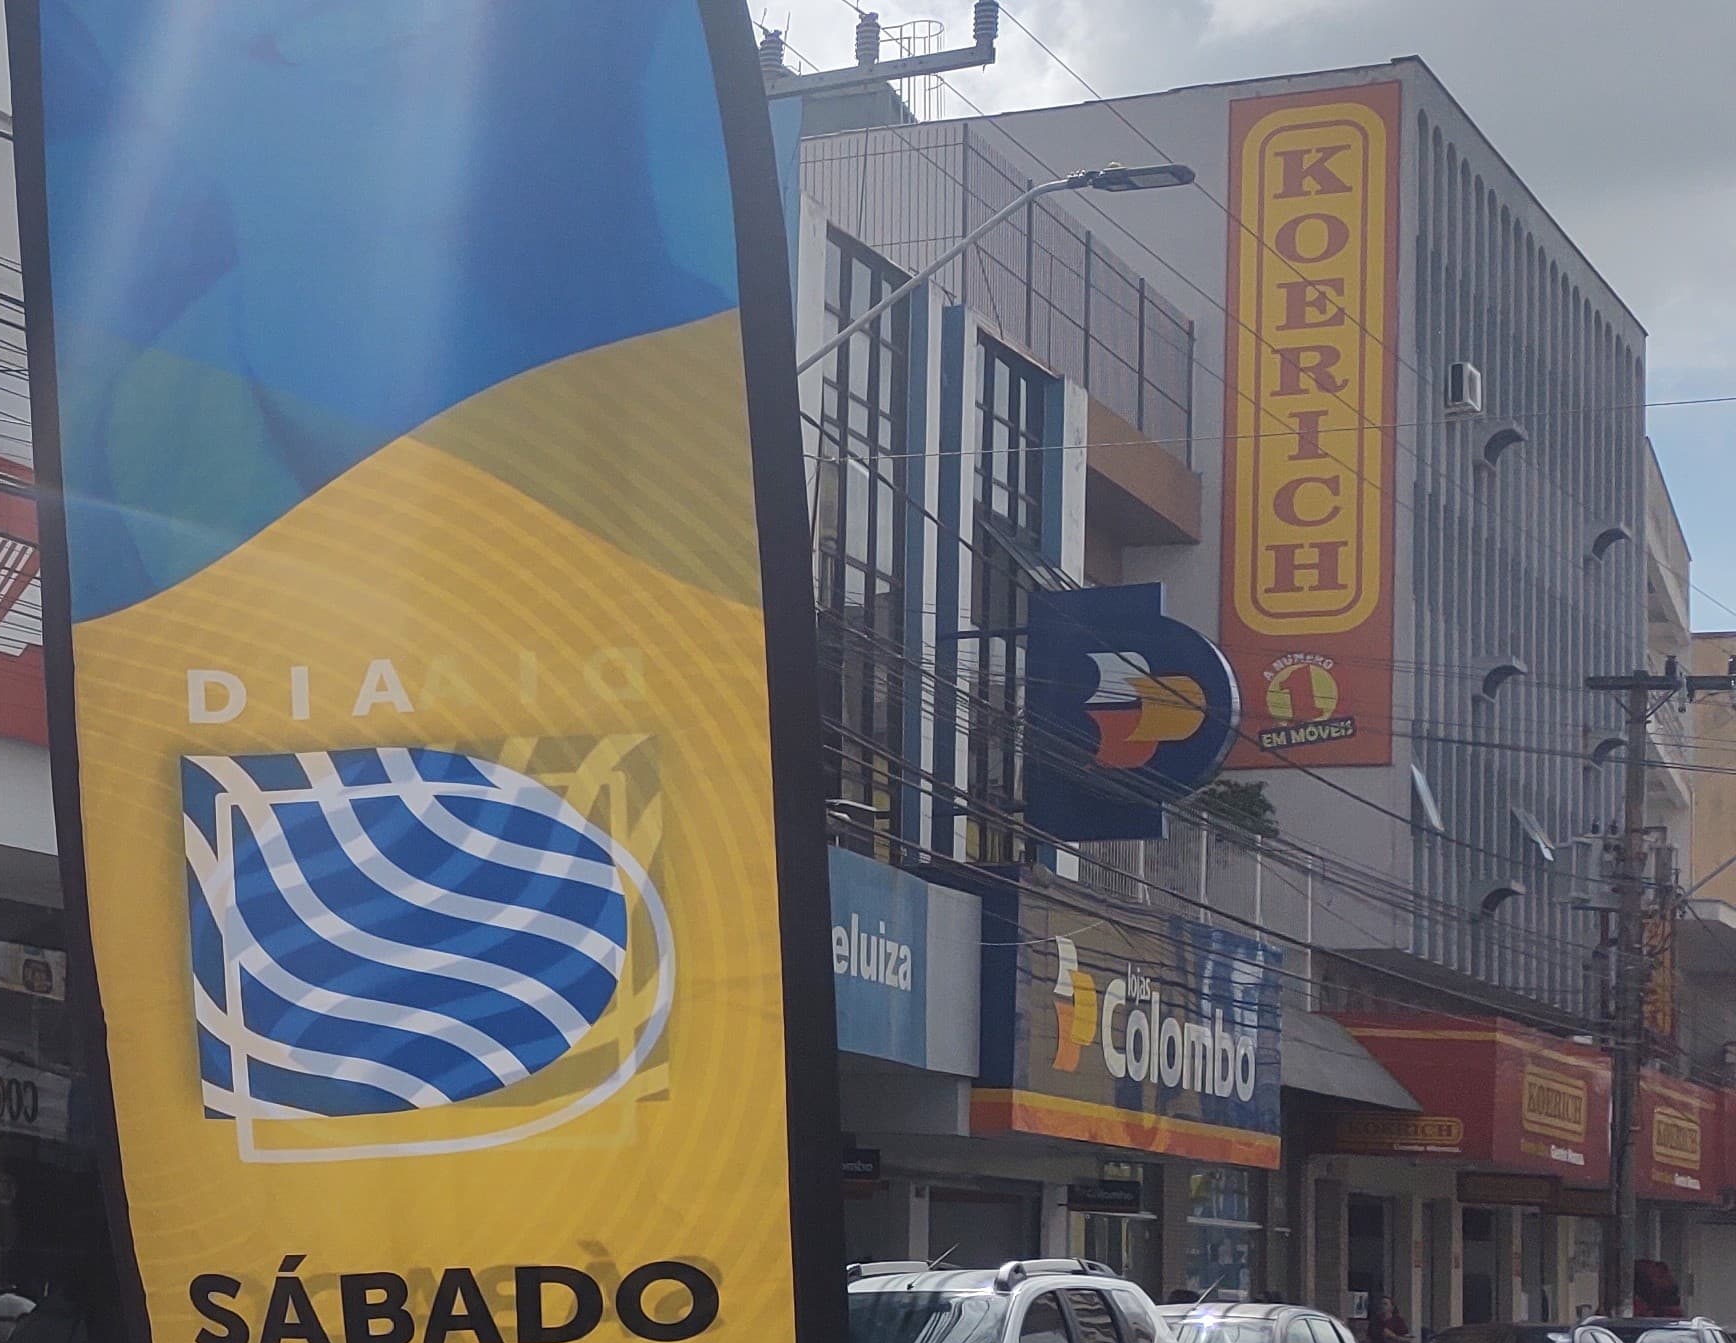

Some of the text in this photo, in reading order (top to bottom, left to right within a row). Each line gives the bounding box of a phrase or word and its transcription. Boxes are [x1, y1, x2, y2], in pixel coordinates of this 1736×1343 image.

[1264, 143, 1353, 594] KOERICH
[186, 659, 414, 724] DIA
[1262, 732, 1287, 748] EM
[1127, 963, 1151, 1001] lojas
[1102, 978, 1257, 1102] Colombo
